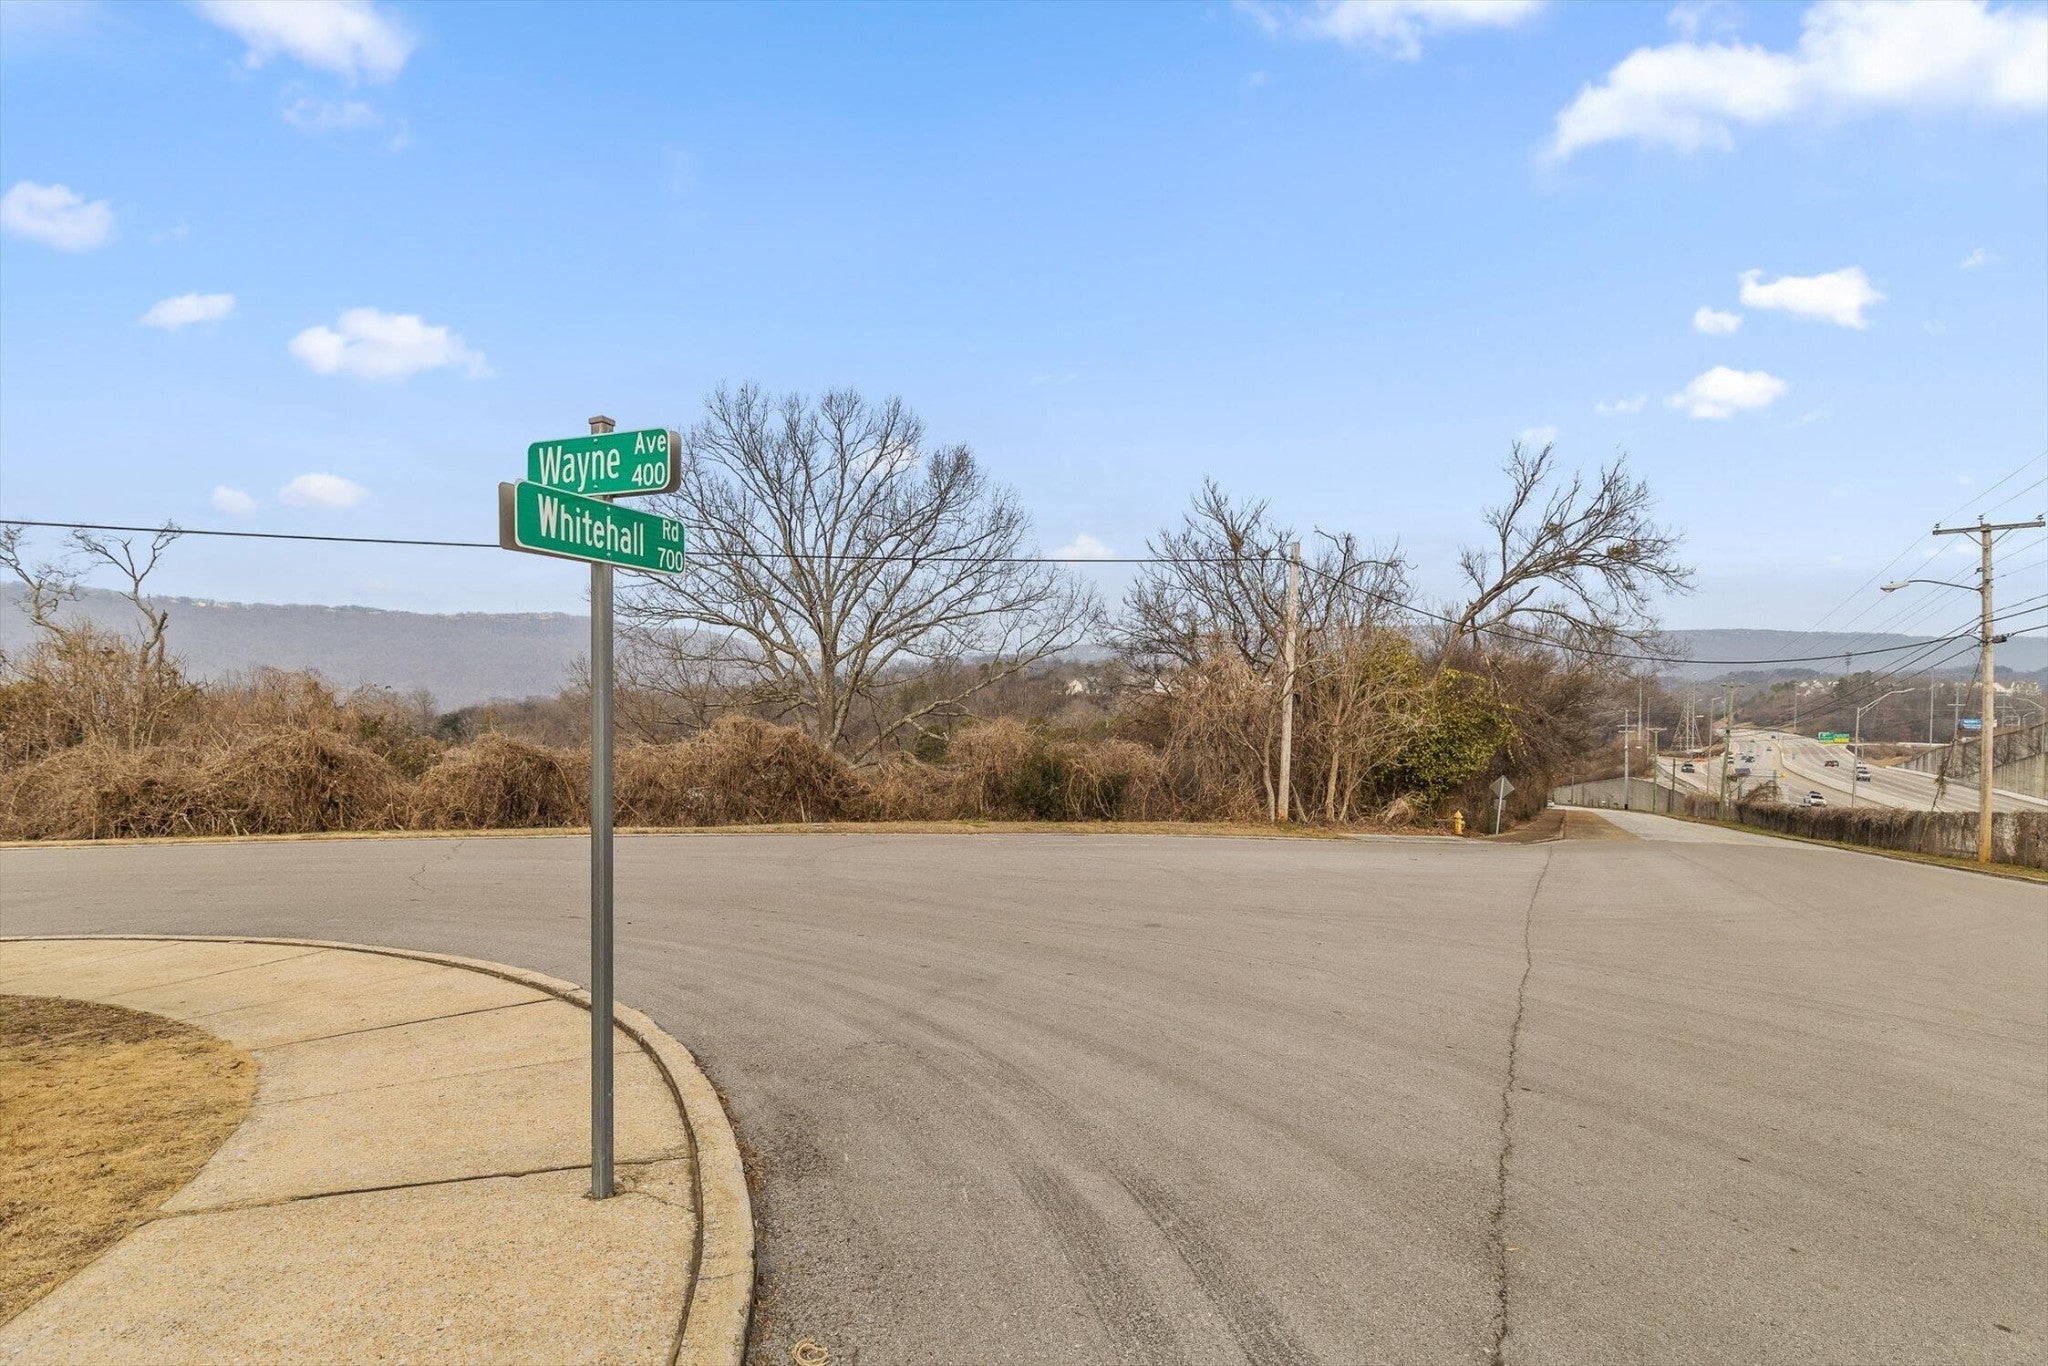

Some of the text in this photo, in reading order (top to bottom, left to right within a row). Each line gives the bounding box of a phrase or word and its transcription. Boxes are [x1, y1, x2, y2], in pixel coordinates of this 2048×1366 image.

[538, 432, 666, 493] Wayne Ave
[631, 462, 665, 487] 400
[537, 493, 679, 556] Whitehall Rd
[657, 547, 683, 571] 700
